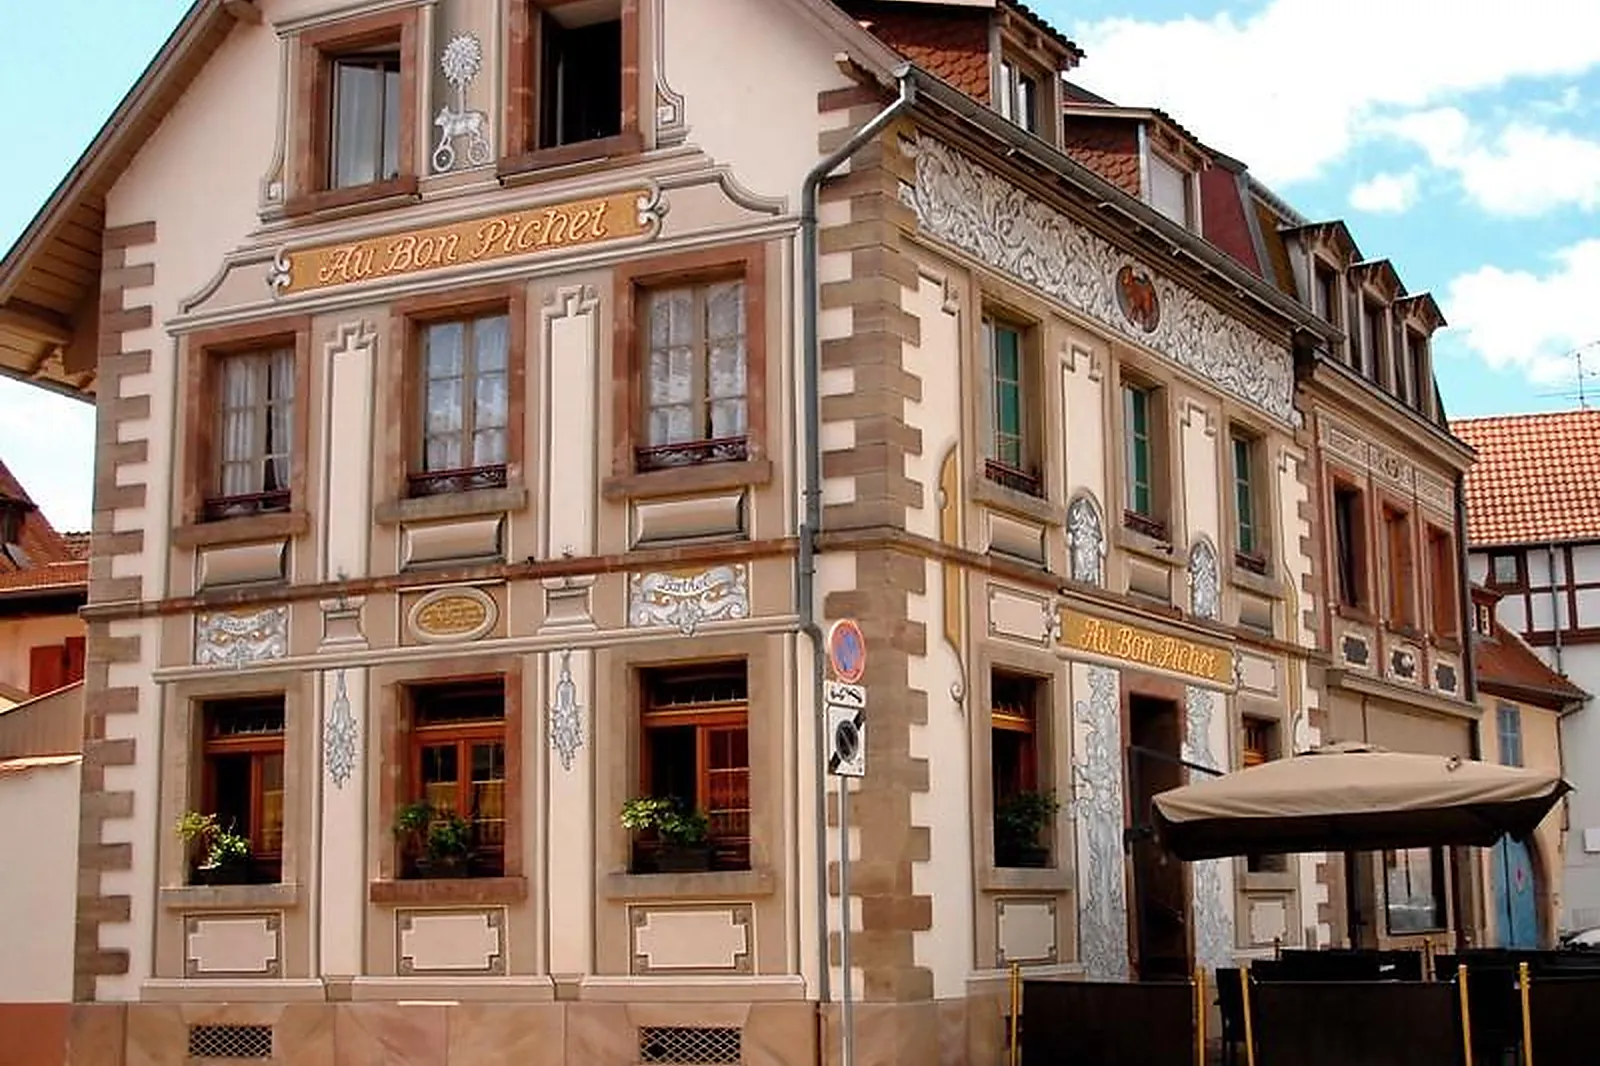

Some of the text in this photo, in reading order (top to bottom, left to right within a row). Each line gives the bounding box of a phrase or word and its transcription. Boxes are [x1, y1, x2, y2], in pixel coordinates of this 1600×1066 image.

[319, 202, 609, 283] Au Bon Pichet
[1080, 619, 1111, 655] Au
[1116, 627, 1153, 663] Bon
